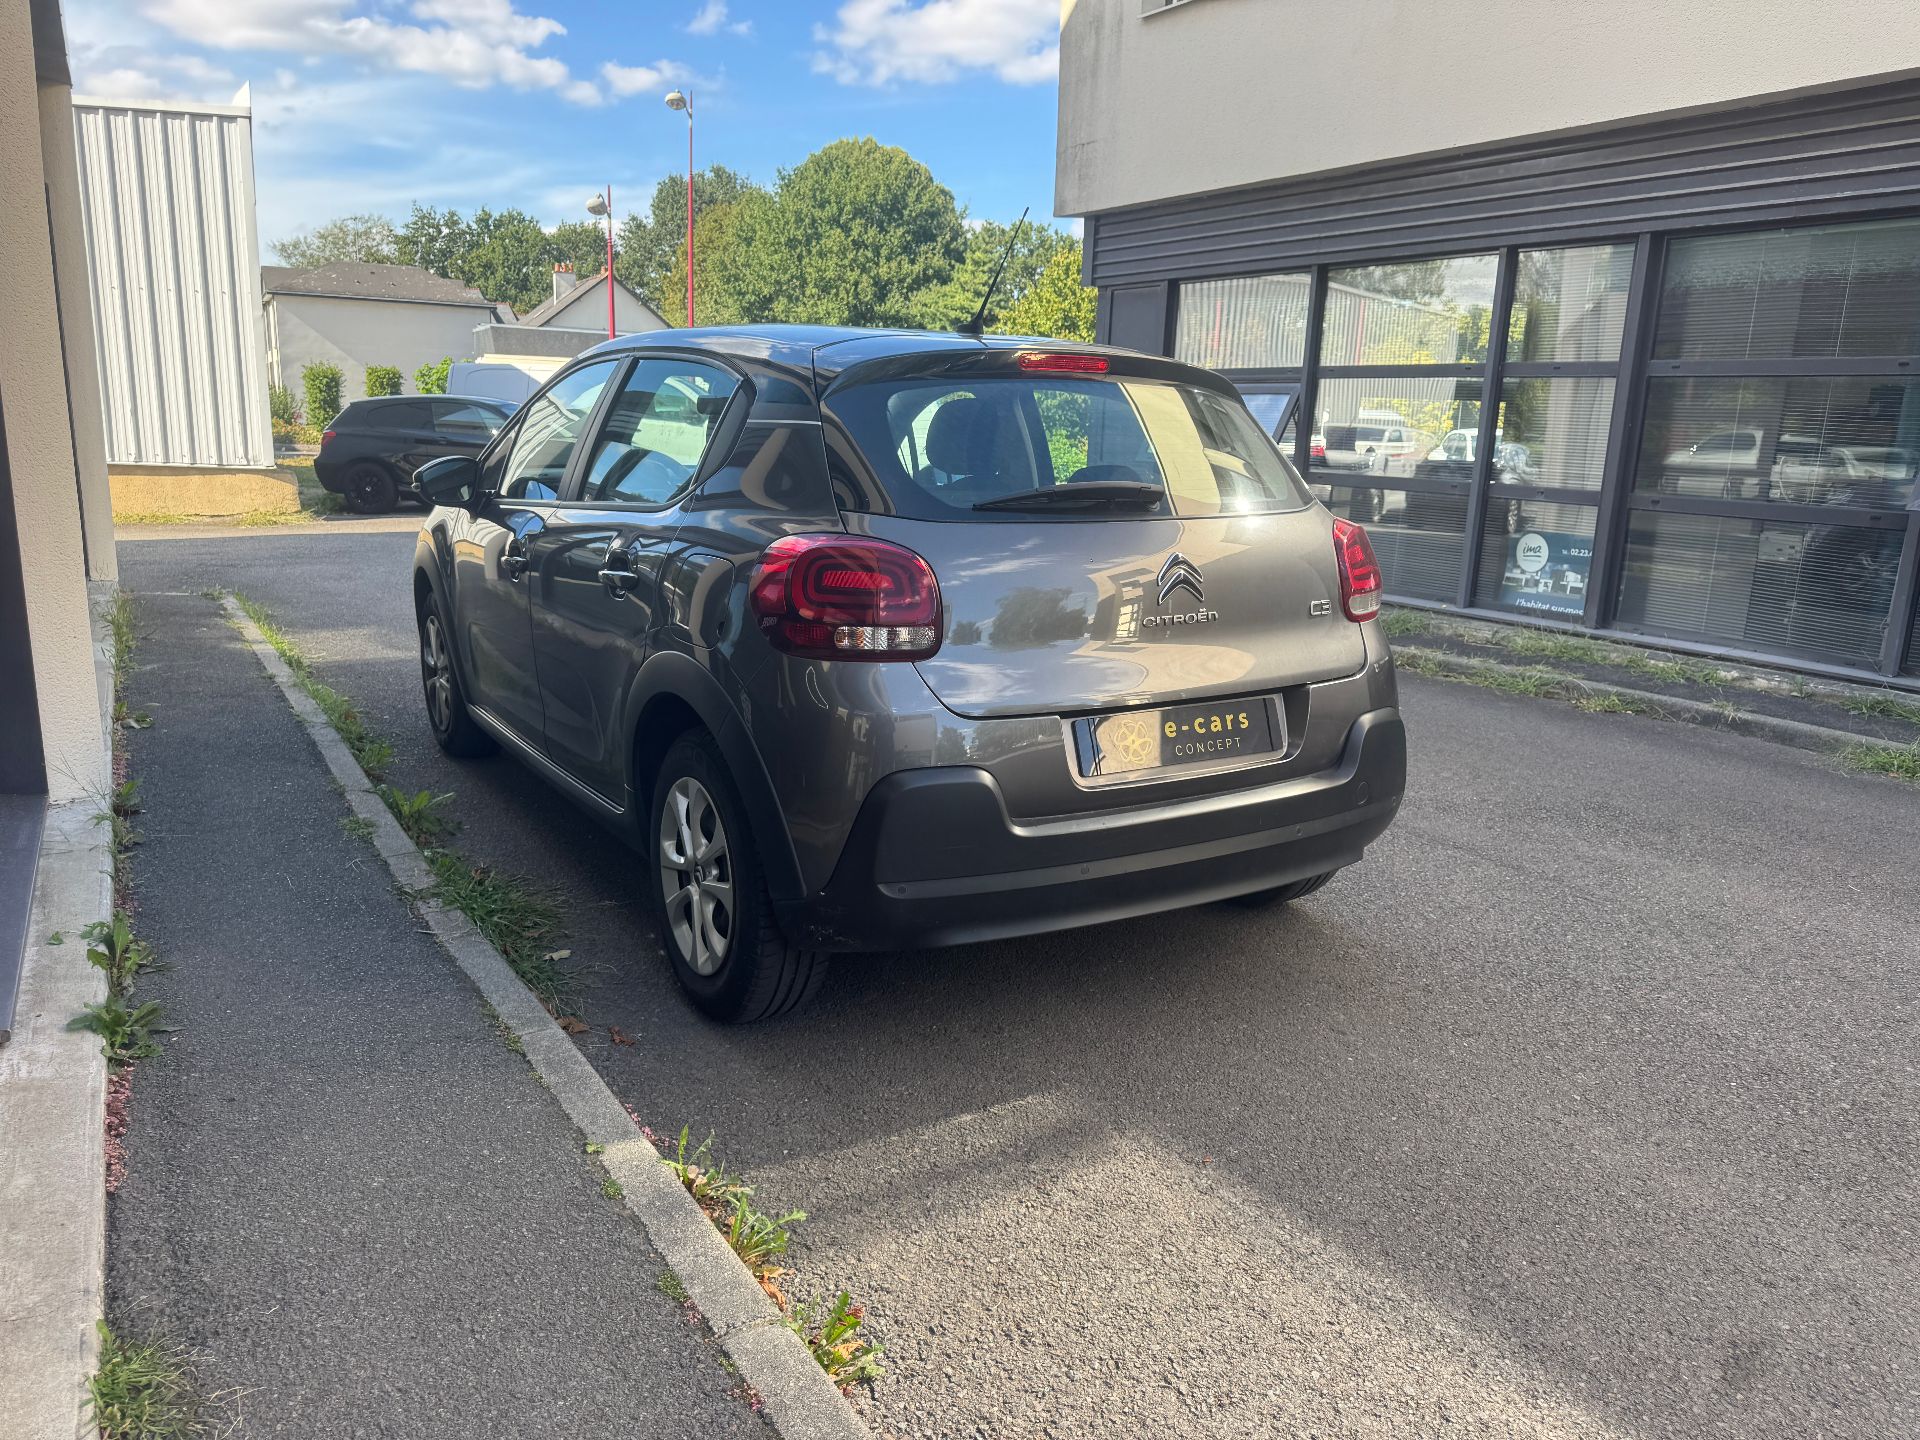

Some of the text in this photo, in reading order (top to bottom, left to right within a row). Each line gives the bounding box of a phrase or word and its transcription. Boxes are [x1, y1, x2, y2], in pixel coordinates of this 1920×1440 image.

[1309, 599, 1331, 616] C3
[1164, 711, 1249, 738] e-cars
[1175, 737, 1242, 756] CONCEPT
